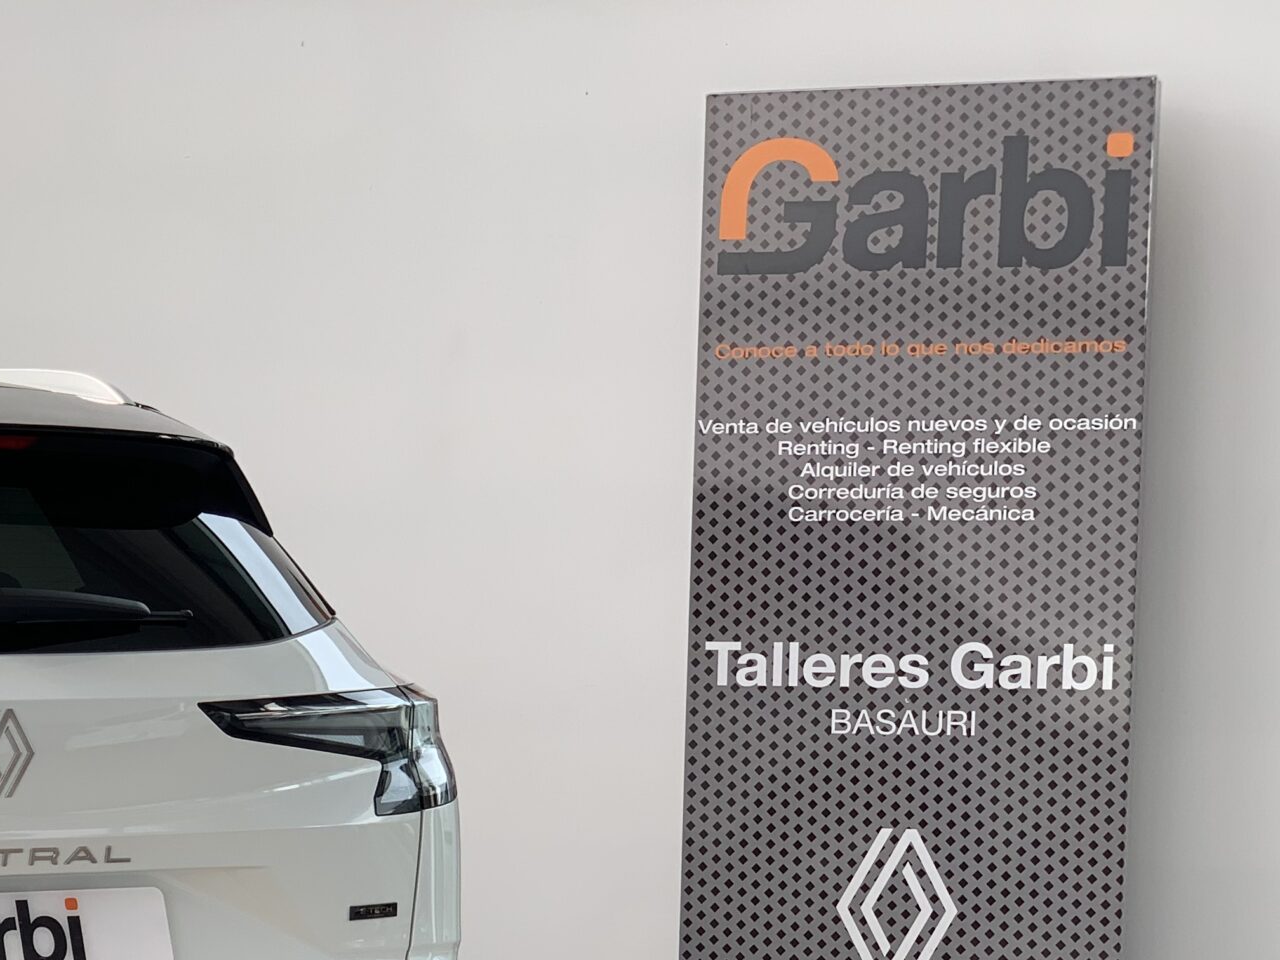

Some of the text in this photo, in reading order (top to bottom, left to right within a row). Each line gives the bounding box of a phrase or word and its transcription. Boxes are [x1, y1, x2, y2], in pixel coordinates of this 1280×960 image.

[717, 132, 1134, 276] Garbi
[714, 338, 1127, 360] Conoce a todo lo que nos dedicamos
[698, 414, 1137, 434] Venta de vehículos nuevos y de ocasión
[778, 440, 859, 458] Renting
[883, 439, 966, 457] Renting
[972, 438, 1051, 454] flexible
[800, 460, 1026, 480] Alquiler de vehículos
[788, 484, 1037, 502] Correduría de seguros
[788, 506, 904, 522] Carrocería
[927, 505, 1035, 521] Mecánica
[704, 641, 1115, 691] Talleres Garbi
[830, 709, 977, 737] BASAURI
